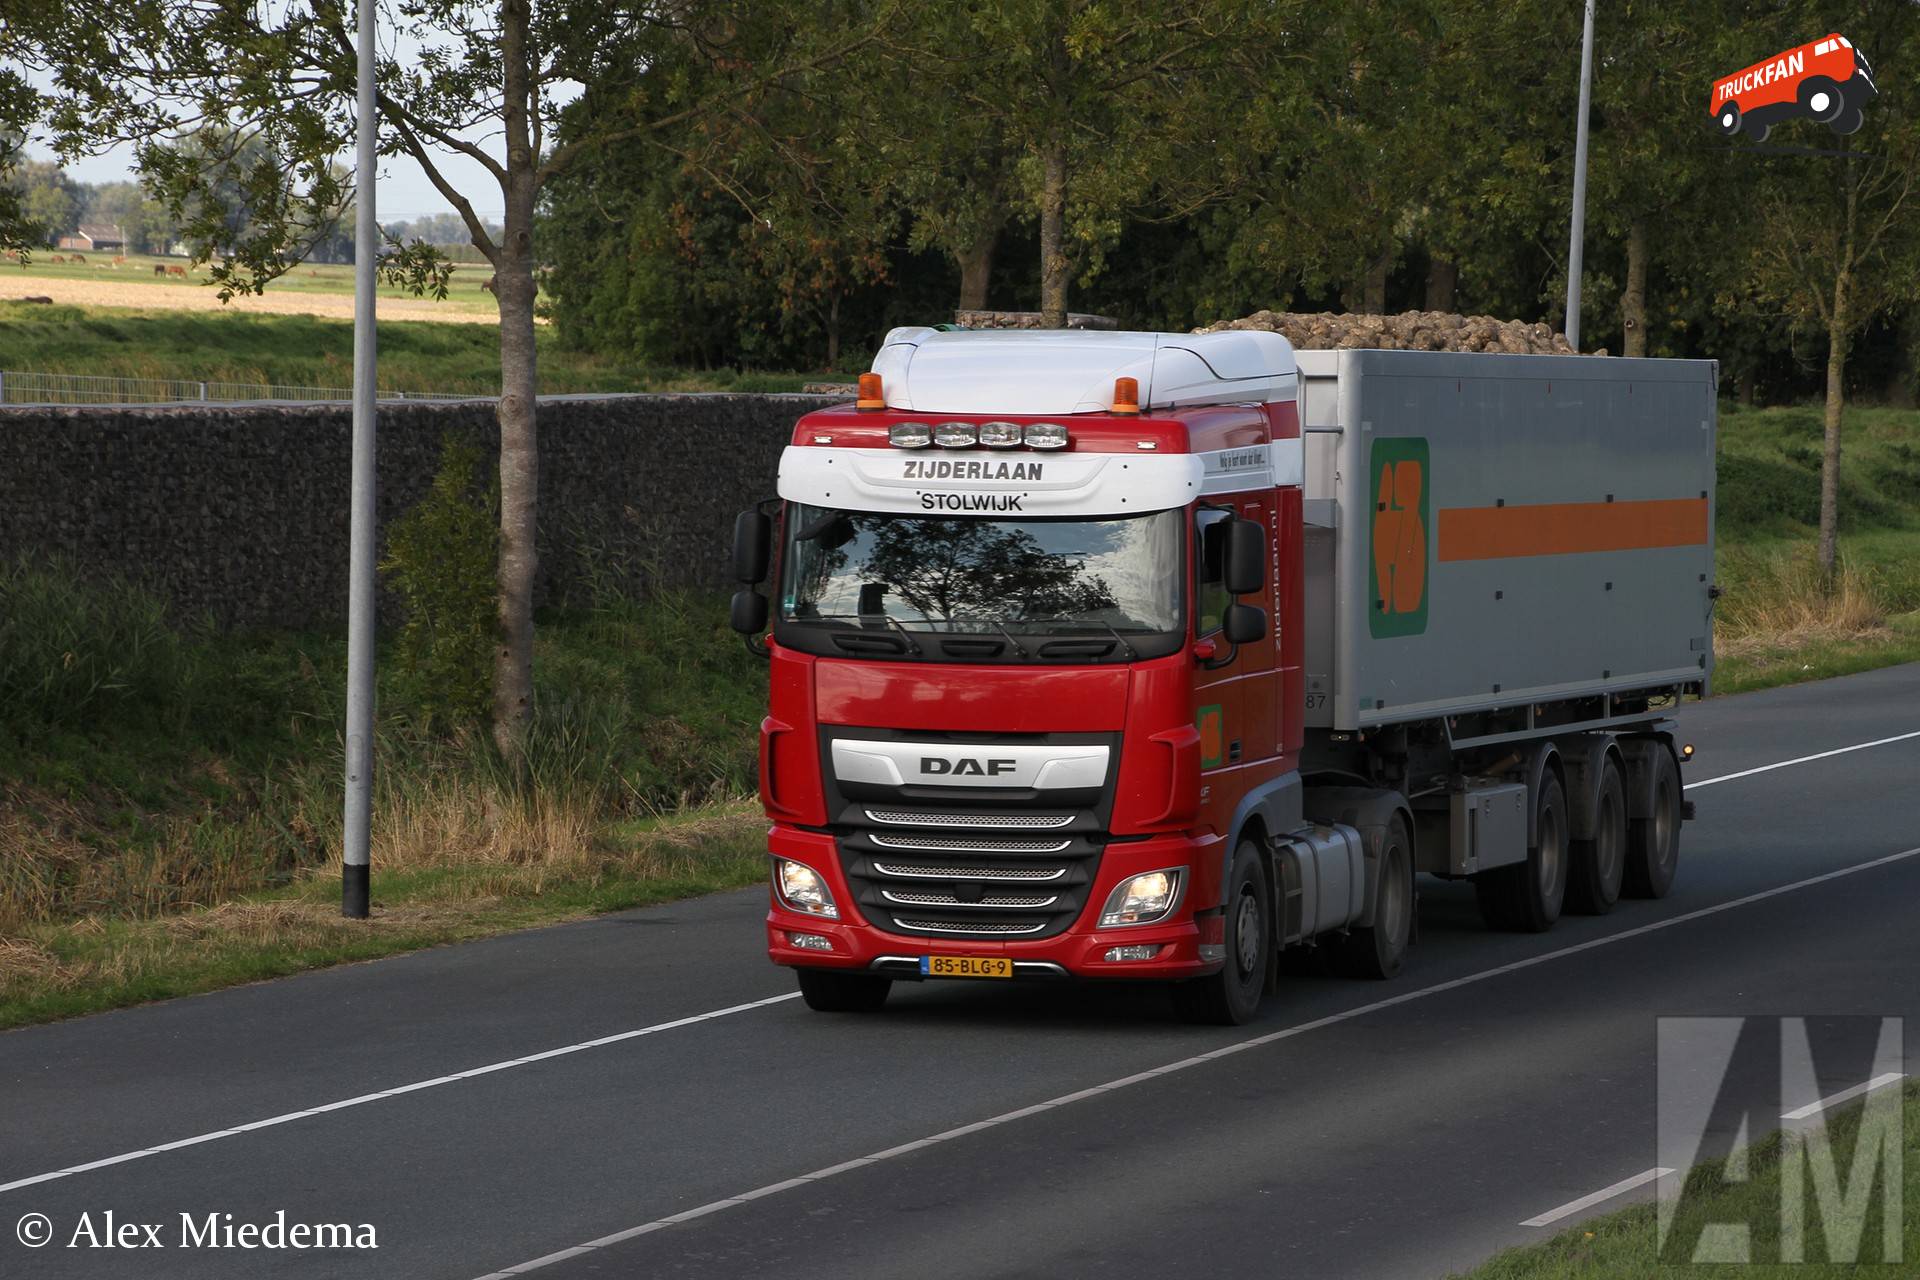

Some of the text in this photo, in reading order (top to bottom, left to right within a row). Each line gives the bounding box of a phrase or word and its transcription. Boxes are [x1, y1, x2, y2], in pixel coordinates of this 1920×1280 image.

[903, 461, 1043, 480] ZIJDERLAAN
[921, 493, 1023, 511] STOLWIJK
[1270, 510, 1281, 651] zijderlaan.nl
[920, 757, 1016, 776] DAF
[934, 958, 1006, 974] 85-BLG-9
